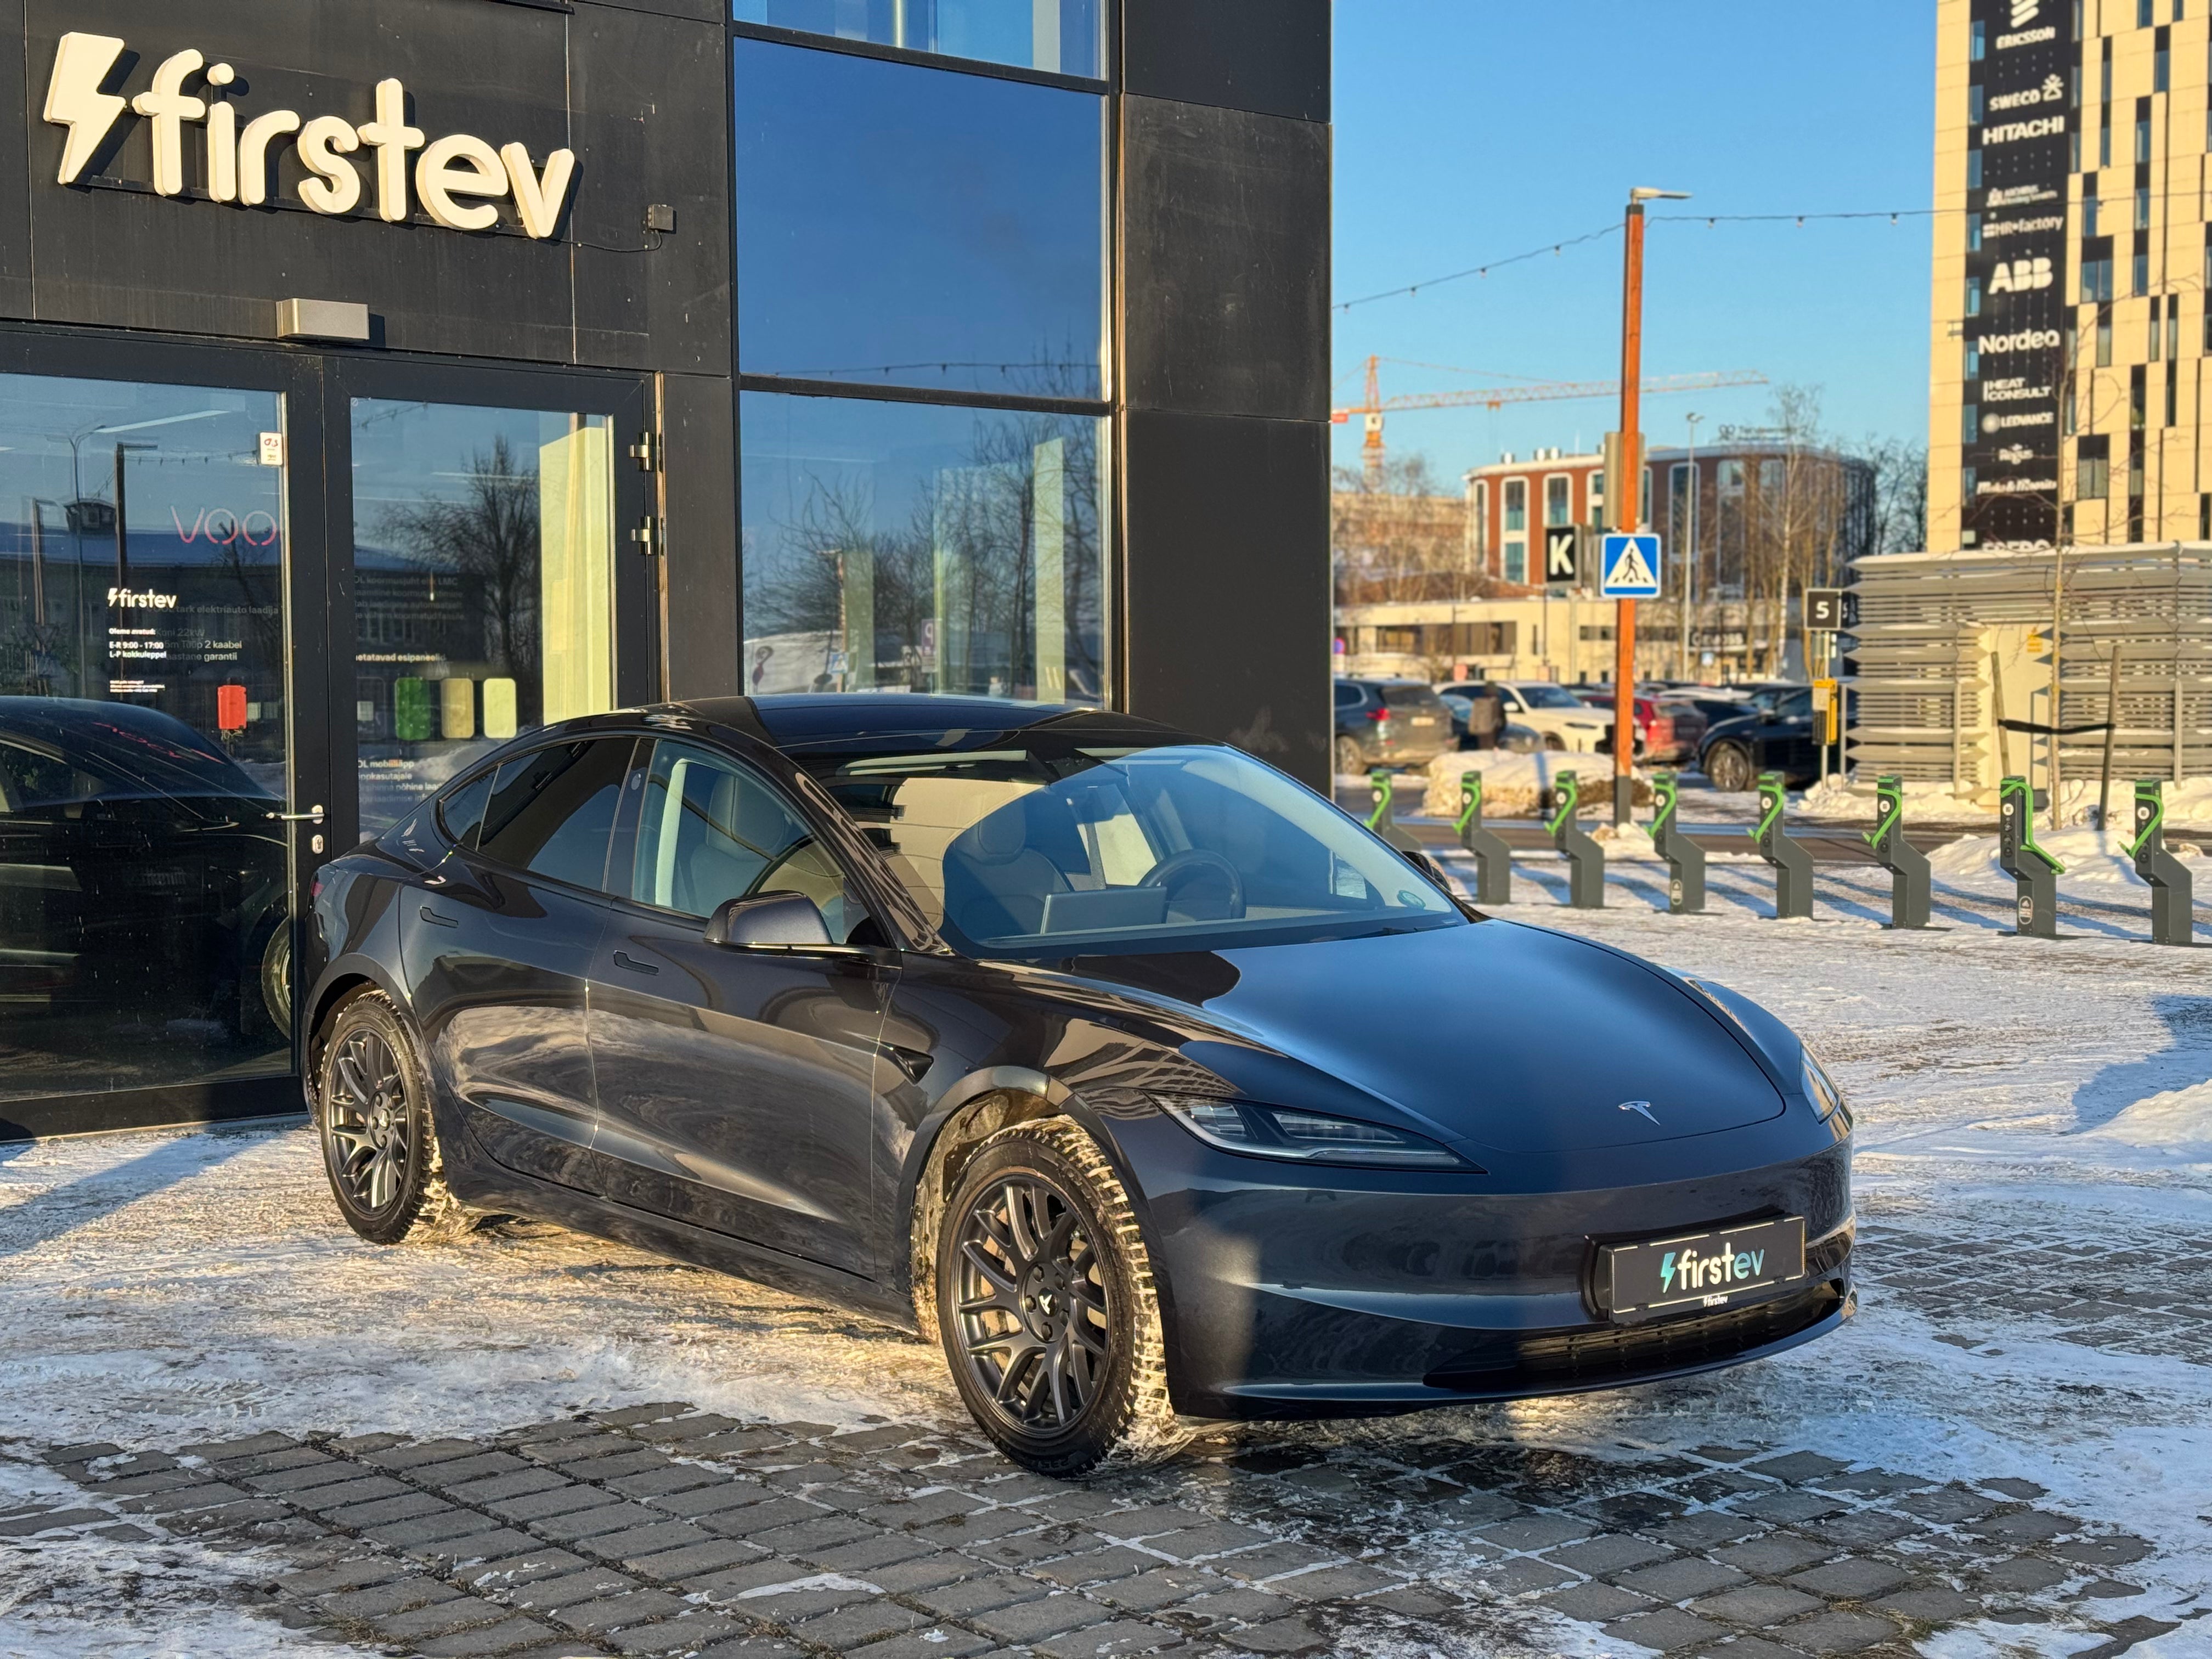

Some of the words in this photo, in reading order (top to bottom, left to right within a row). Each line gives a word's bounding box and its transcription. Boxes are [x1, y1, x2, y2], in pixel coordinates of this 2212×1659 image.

[1995, 26, 2056, 49] ERICSSON
[1989, 88, 2041, 111] SWECO
[1982, 115, 2065, 145] HITACHI
[132, 48, 575, 239] firstev
[1988, 257, 2053, 295] ABB
[1978, 329, 2060, 355] Nordea
[1989, 377, 2025, 390] HEAT
[1988, 386, 2052, 402] CONSULT
[2000, 411, 2055, 428] LEDVANCE
[170, 505, 278, 546] VOO
[1549, 533, 1575, 575] K
[118, 588, 177, 608] firstev
[196, 605, 247, 614] elektriauto
[249, 605, 279, 616] laadija
[122, 650, 167, 660] kokkuleppel
[144, 641, 165, 650] 17:00
[204, 640, 212, 649] 2
[212, 640, 242, 650] kaabel
[204, 651, 238, 663] garantii
[356, 653, 396, 662] etatavad
[1677, 1242, 1765, 1290] firstev
